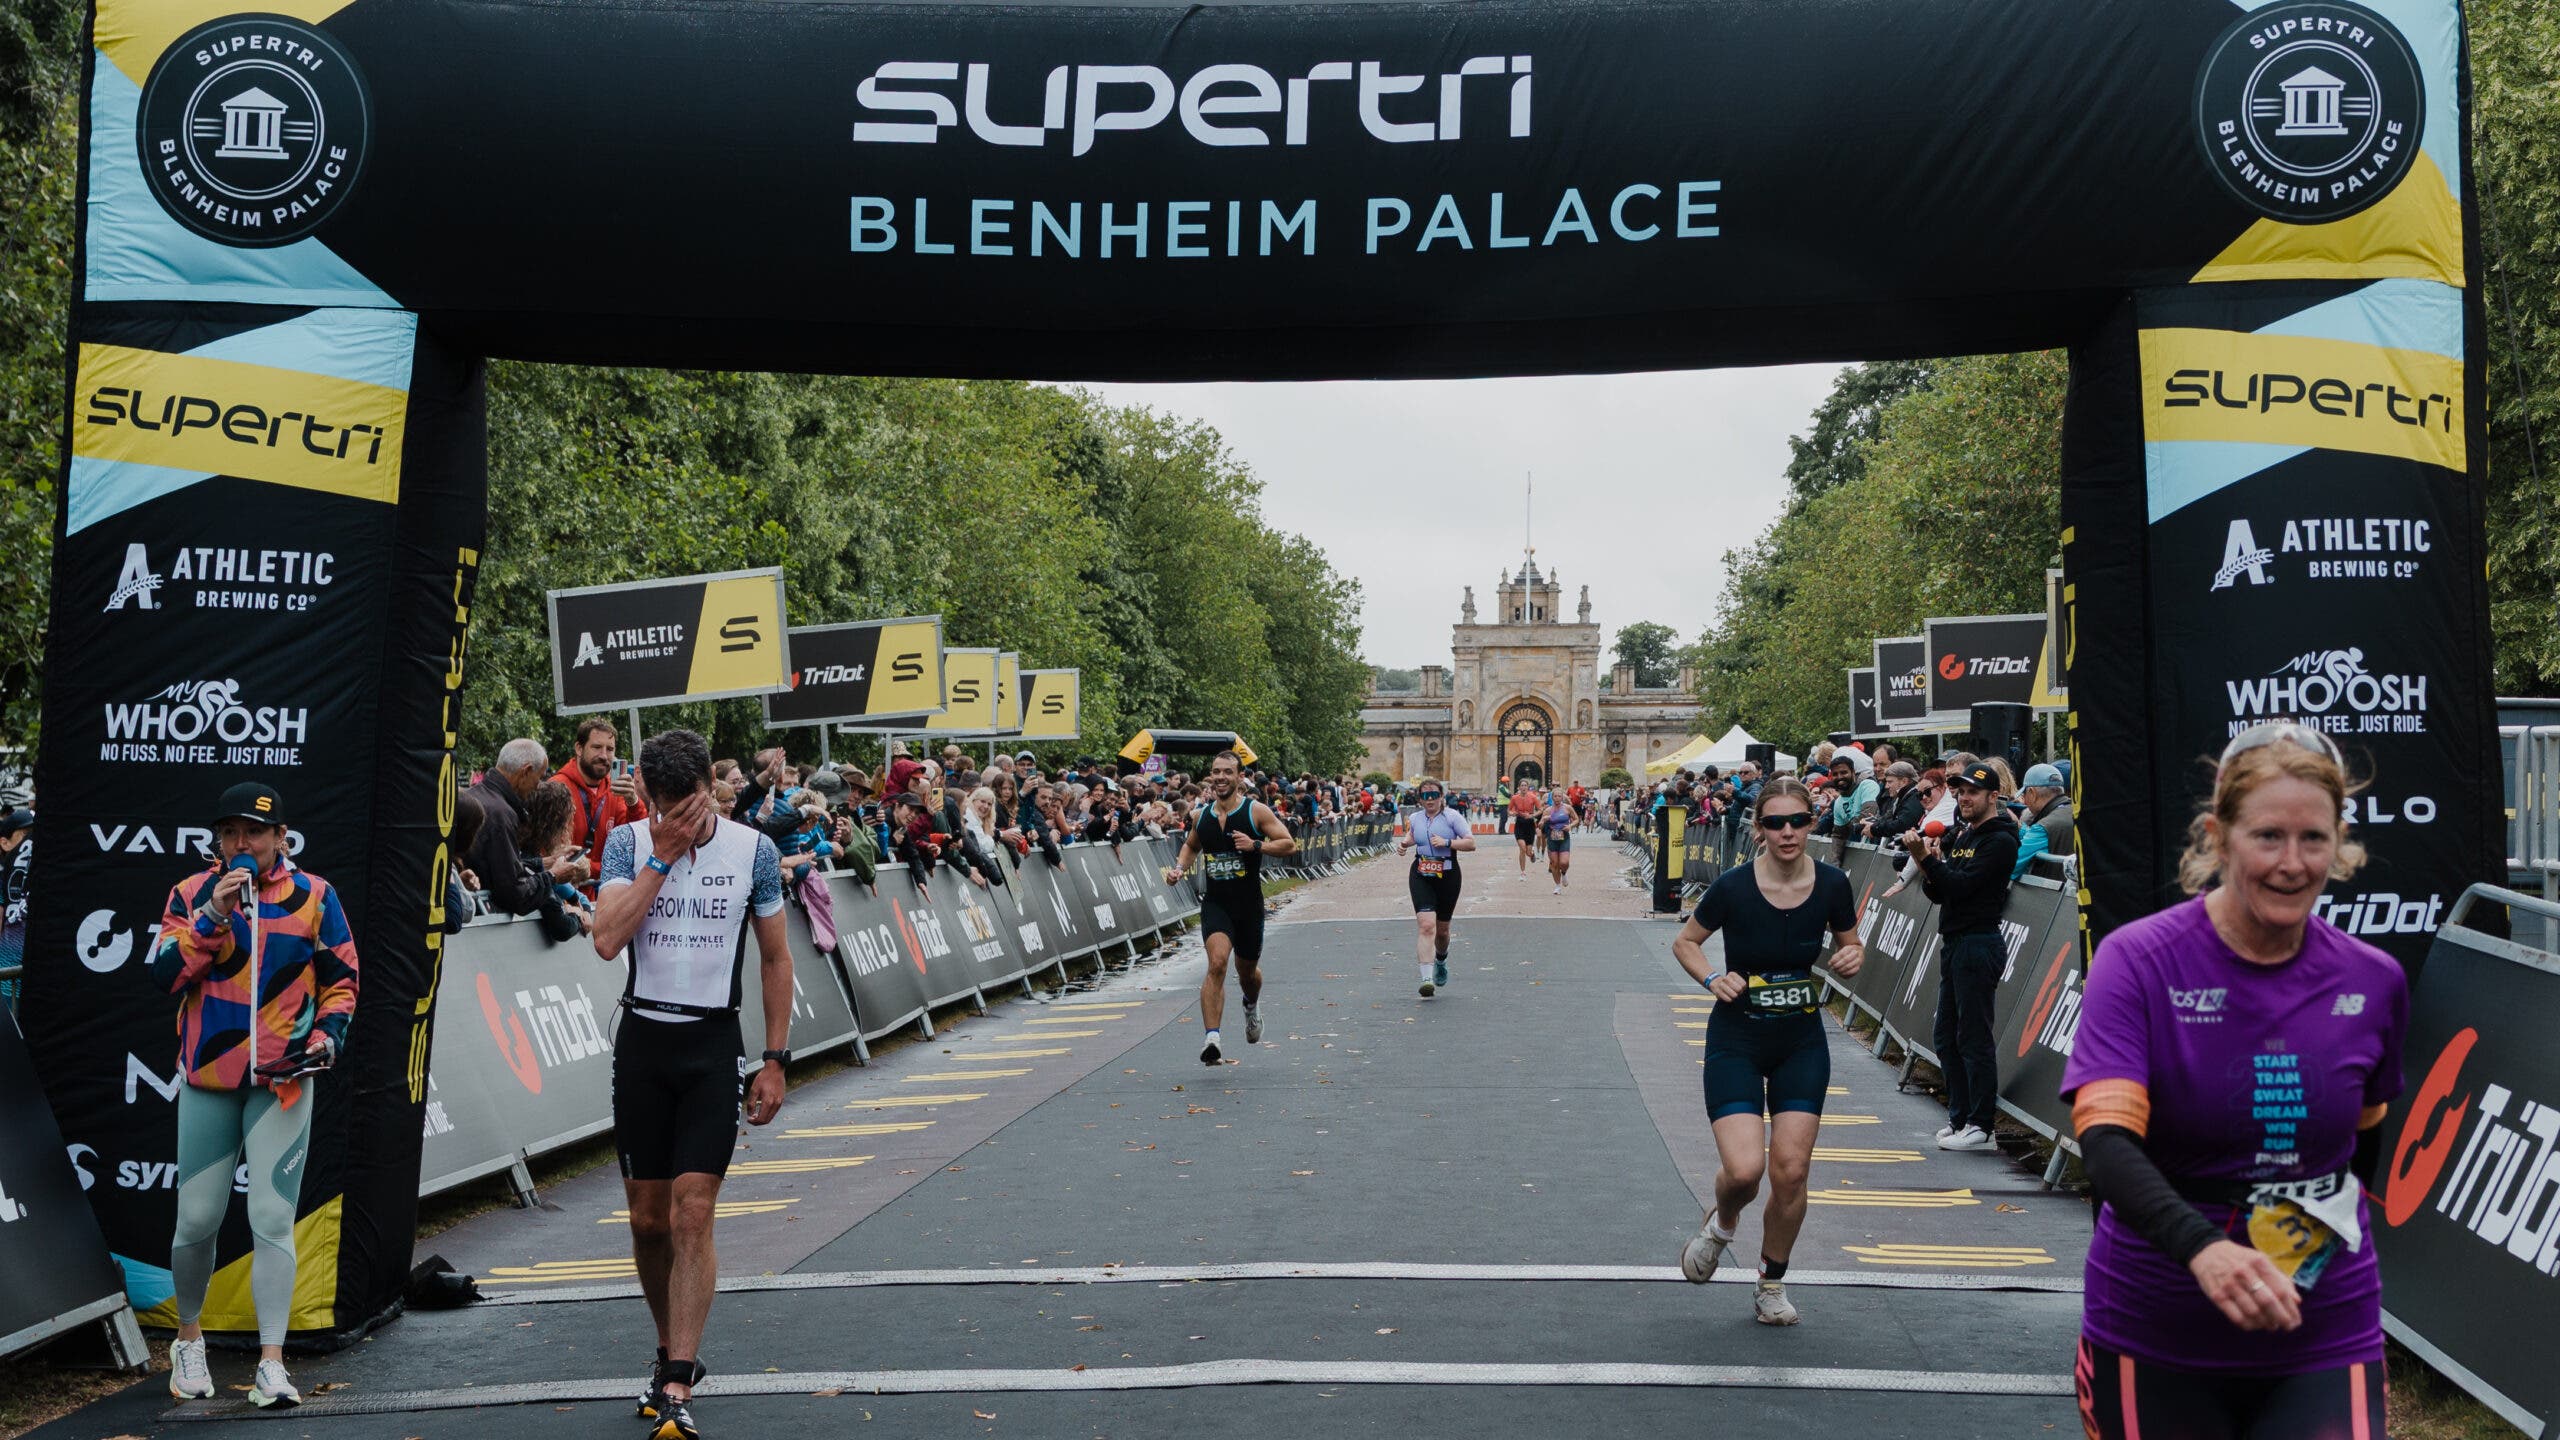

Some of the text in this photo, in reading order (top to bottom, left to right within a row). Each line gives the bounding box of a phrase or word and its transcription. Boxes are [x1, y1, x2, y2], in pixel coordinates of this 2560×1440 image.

[2250, 16, 2375, 49] SUPERTRI
[196, 34, 324, 72] SUPERTRI
[853, 55, 1532, 156] supertri
[2218, 119, 2403, 203] BLENHEIM PALACE
[159, 138, 348, 228] BLENHEIM PALACE
[850, 180, 1722, 258] BLENHEIM PALACE
[2164, 368, 2451, 434] supertri
[87, 386, 384, 465] supertri
[2281, 518, 2431, 553] ATHLETIC
[171, 547, 335, 586] ATHLETIC
[2309, 560, 2388, 578] BREWING
[195, 590, 279, 610] BREWING
[606, 624, 684, 649] ATHLETIC
[620, 648, 660, 660] BREWING
[1969, 656, 2031, 676] TriDot
[804, 664, 865, 685] TriDot
[2226, 674, 2427, 717] WHOOSH
[105, 703, 308, 744] WHOOSH
[2324, 715, 2353, 733] FEE.
[2357, 714, 2391, 733] JUST
[2393, 714, 2427, 732] RIDE.
[100, 743, 303, 766] NO FUSS. NO FEE. JUST RIDE.
[90, 823, 305, 855] VARO
[701, 875, 736, 887] OGT
[1876, 908, 1915, 961] VARLO
[842, 923, 899, 977] VARLO
[1760, 986, 1812, 1007] 5381
[2252, 1054, 2299, 1069] START
[2255, 1072, 2301, 1085] TRAIN
[2252, 1088, 2304, 1103] SWEAT
[2251, 1105, 2308, 1120] DREAM
[2264, 1122, 2297, 1135] WIN
[2262, 1138, 2296, 1151] RUN
[282, 1148, 305, 1175] HOKA
